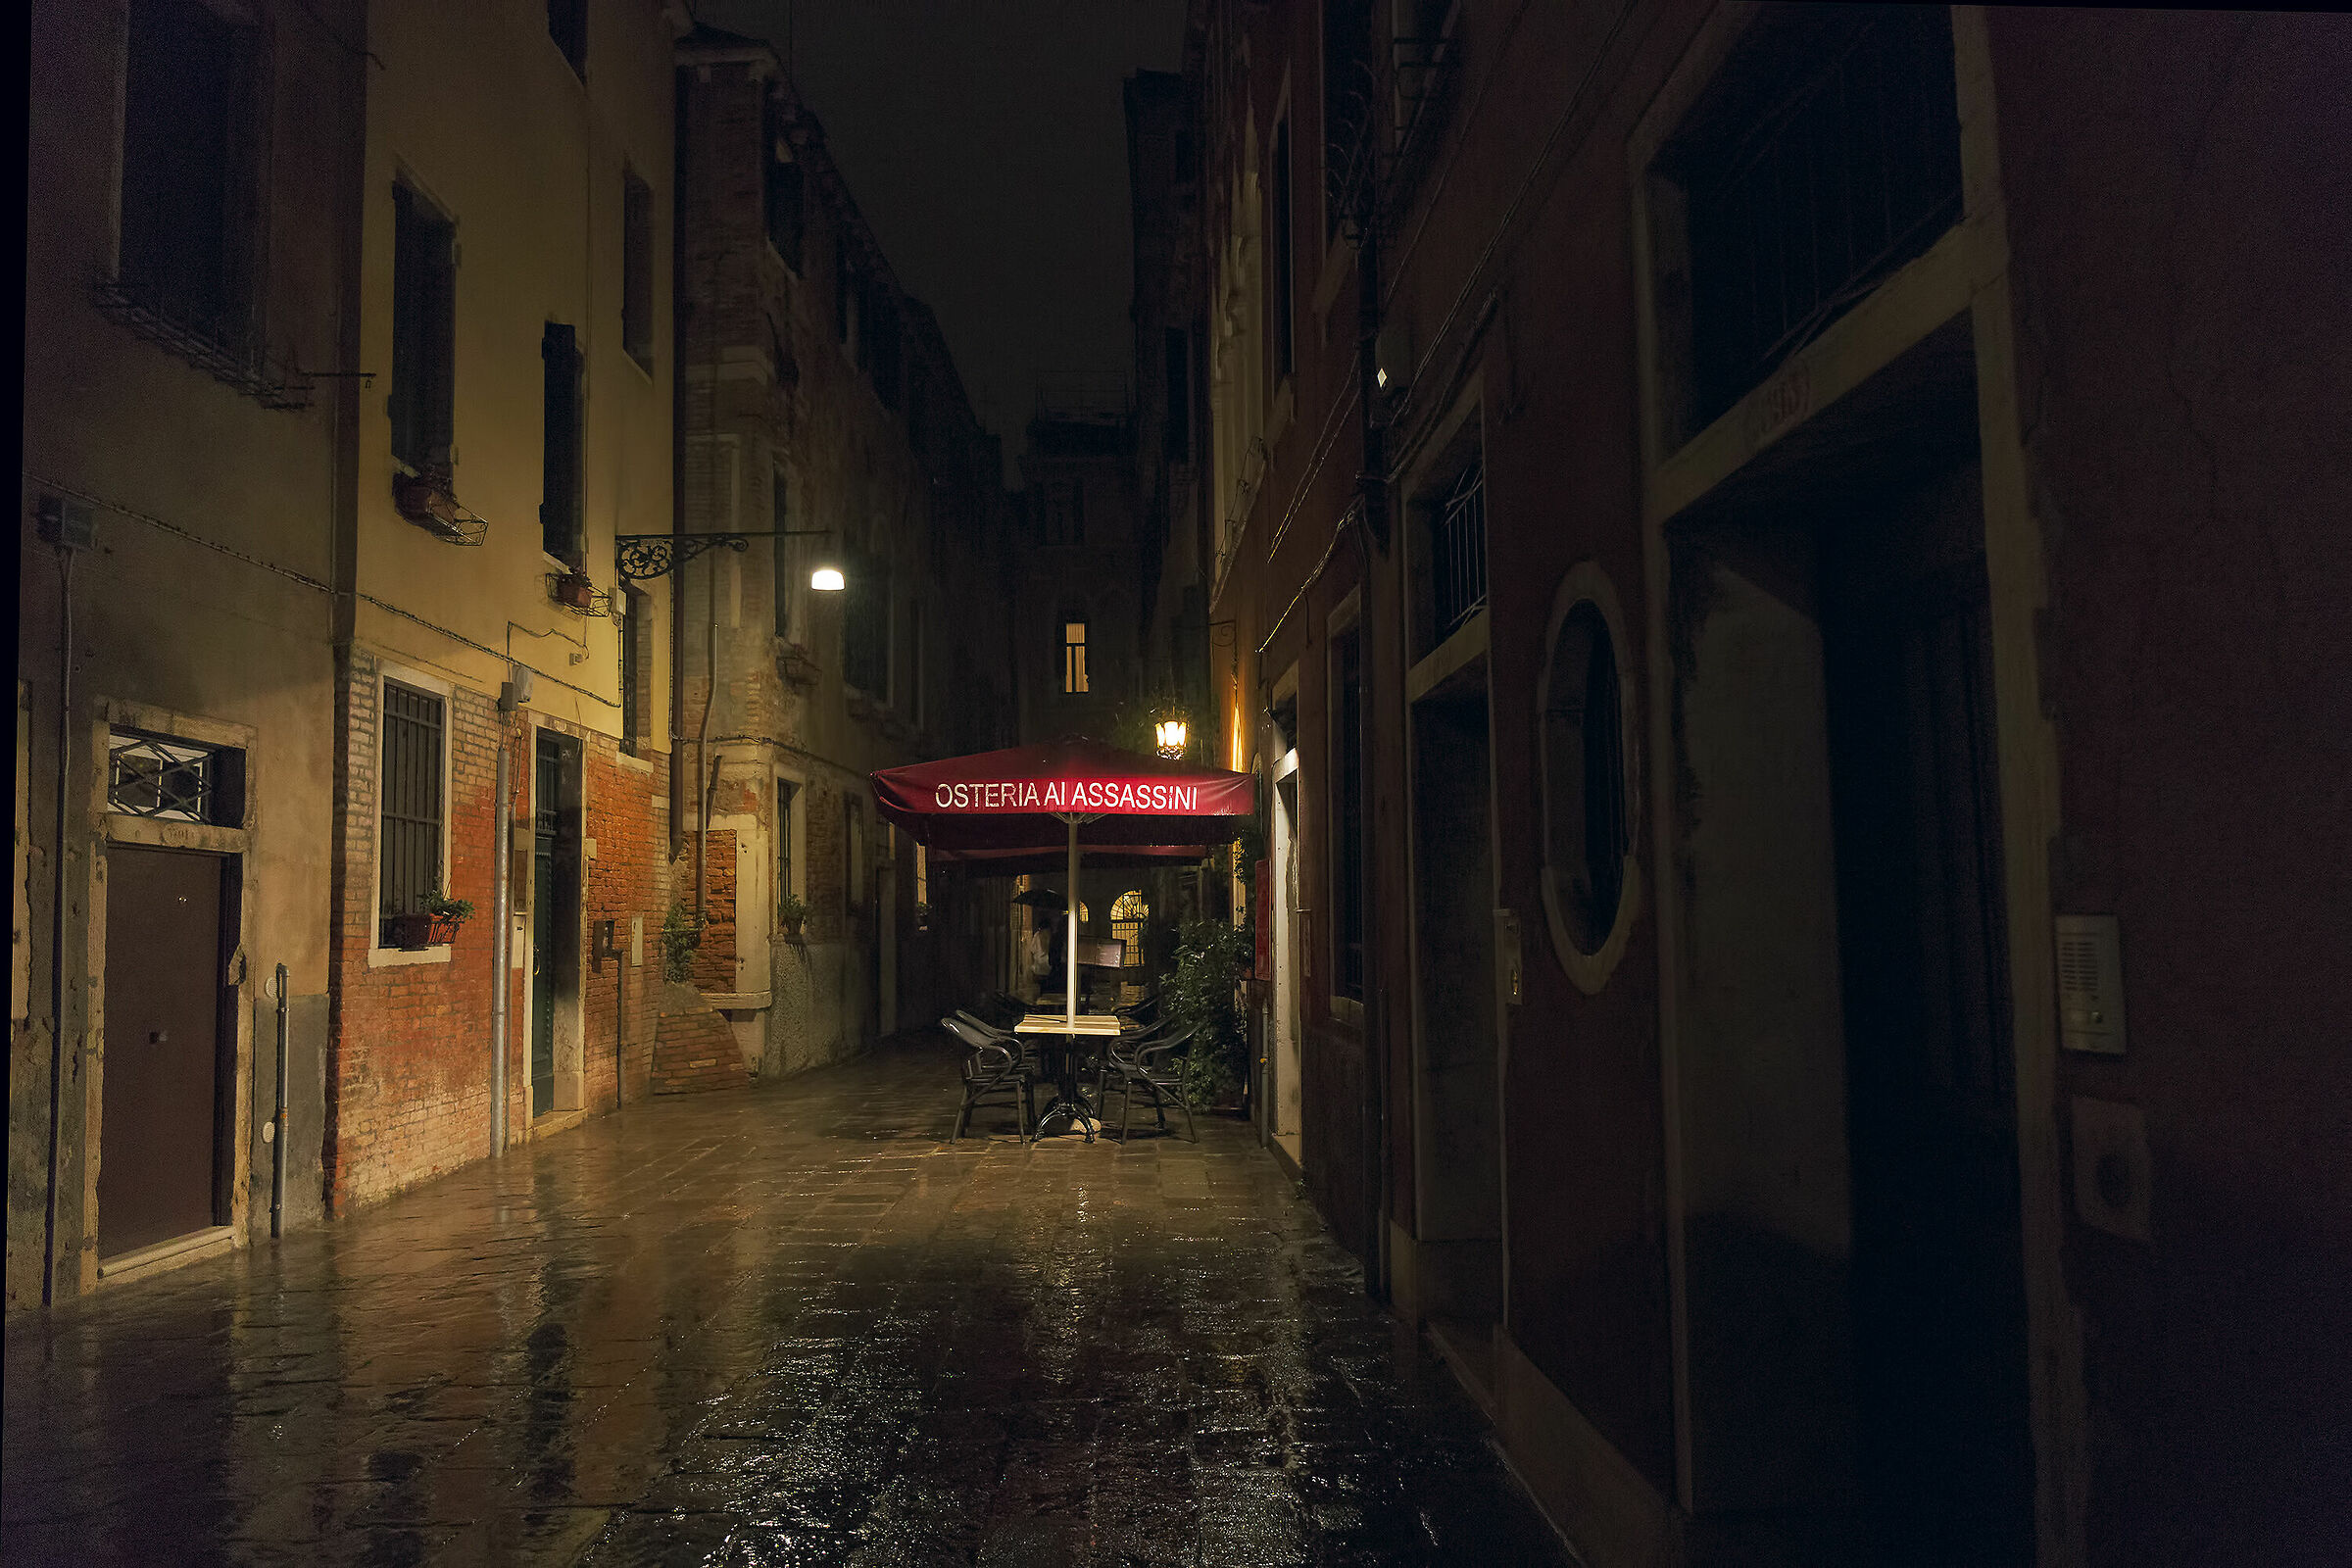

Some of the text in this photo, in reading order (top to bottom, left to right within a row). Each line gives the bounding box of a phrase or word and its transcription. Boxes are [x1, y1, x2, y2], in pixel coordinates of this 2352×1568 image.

[935, 781, 1198, 810] OSTERIA AI ASSASSINI
